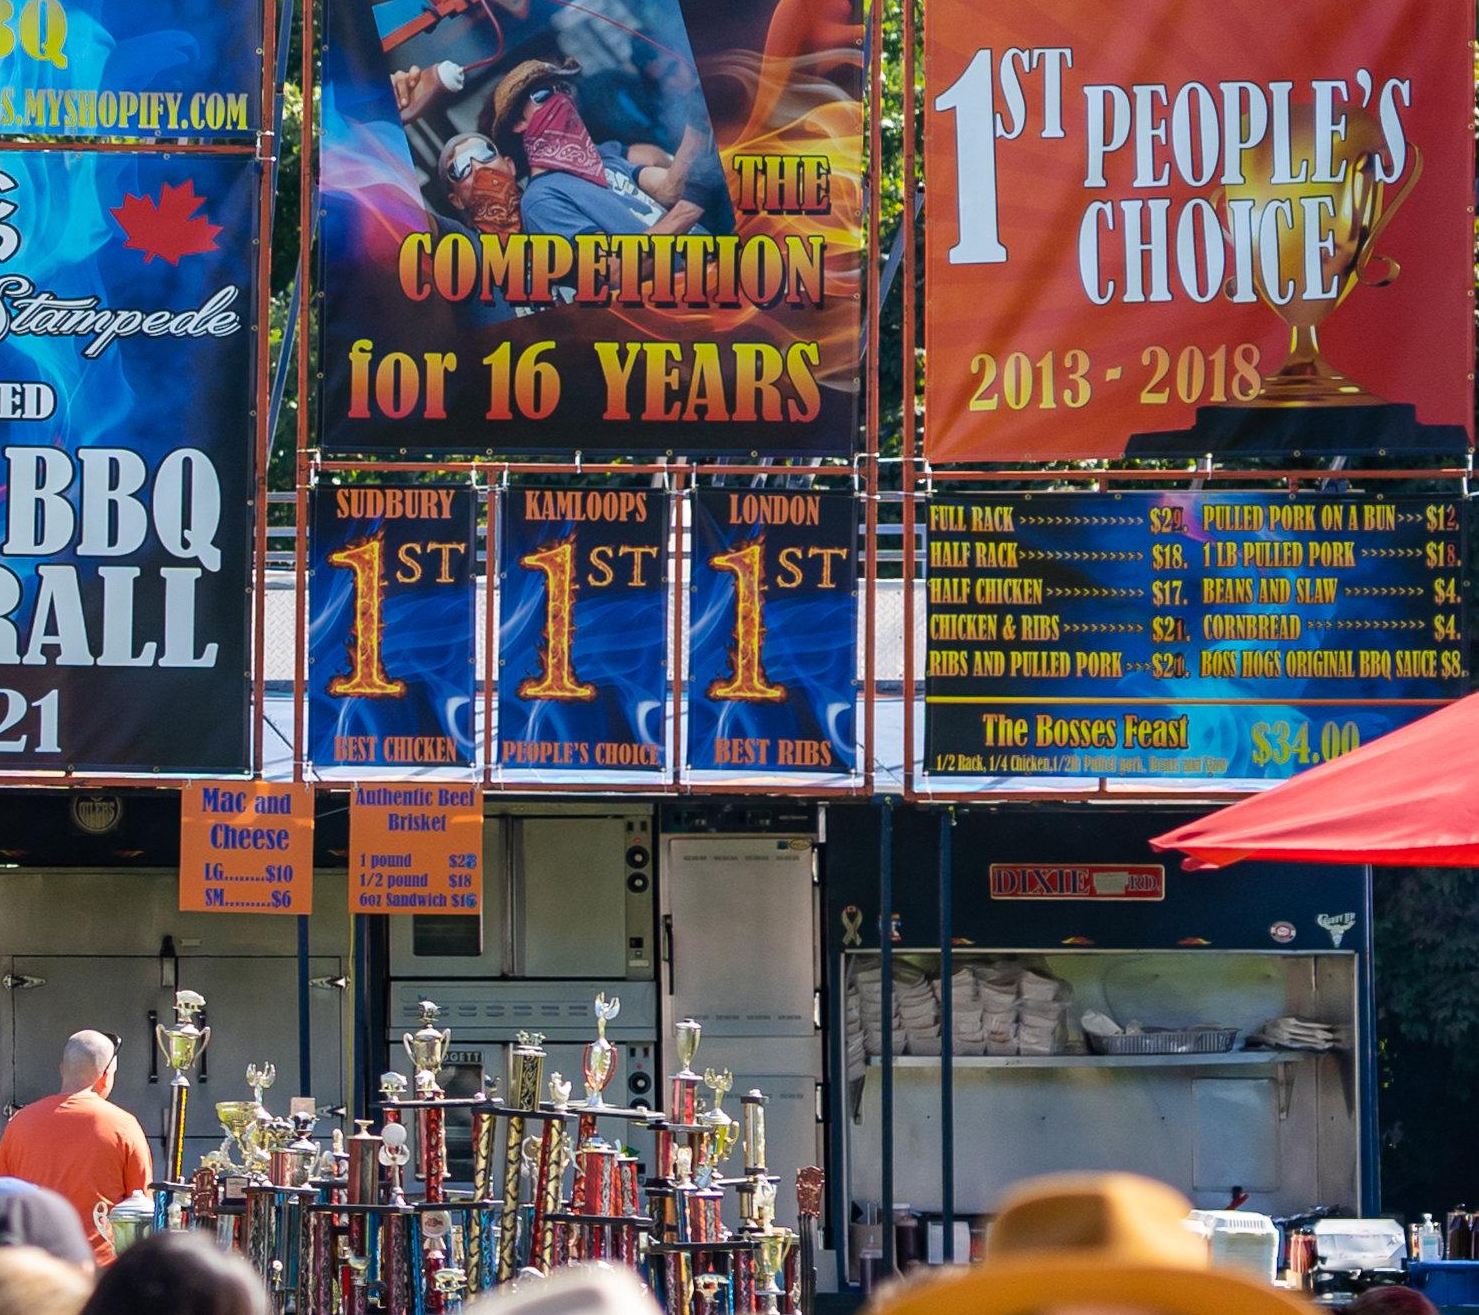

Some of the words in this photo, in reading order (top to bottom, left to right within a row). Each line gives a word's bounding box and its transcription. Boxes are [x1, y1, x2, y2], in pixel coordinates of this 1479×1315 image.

[935, 47, 1074, 265] 1ST
[1083, 68, 1414, 188] PEOPLE'S
[733, 154, 833, 216] THE
[399, 232, 824, 308] COMPETITION
[1078, 195, 1340, 306] CHOICE
[348, 337, 457, 420] for
[482, 341, 561, 421] 16
[593, 340, 821, 423] YEARS
[970, 349, 1096, 411] 2013
[1139, 343, 1263, 406] 2018
[2, 447, 222, 572] BBQ
[335, 490, 454, 523] SUDBURY
[202, 788, 247, 813] Mac
[254, 793, 291, 814] and
[356, 788, 433, 807] Authentic
[438, 788, 475, 806] Beef
[210, 823, 290, 850] Cheese
[388, 813, 447, 831] Brisket
[360, 873, 382, 887] 1/2
[388, 873, 428, 889] pound
[994, 868, 1090, 895] DIXIE
